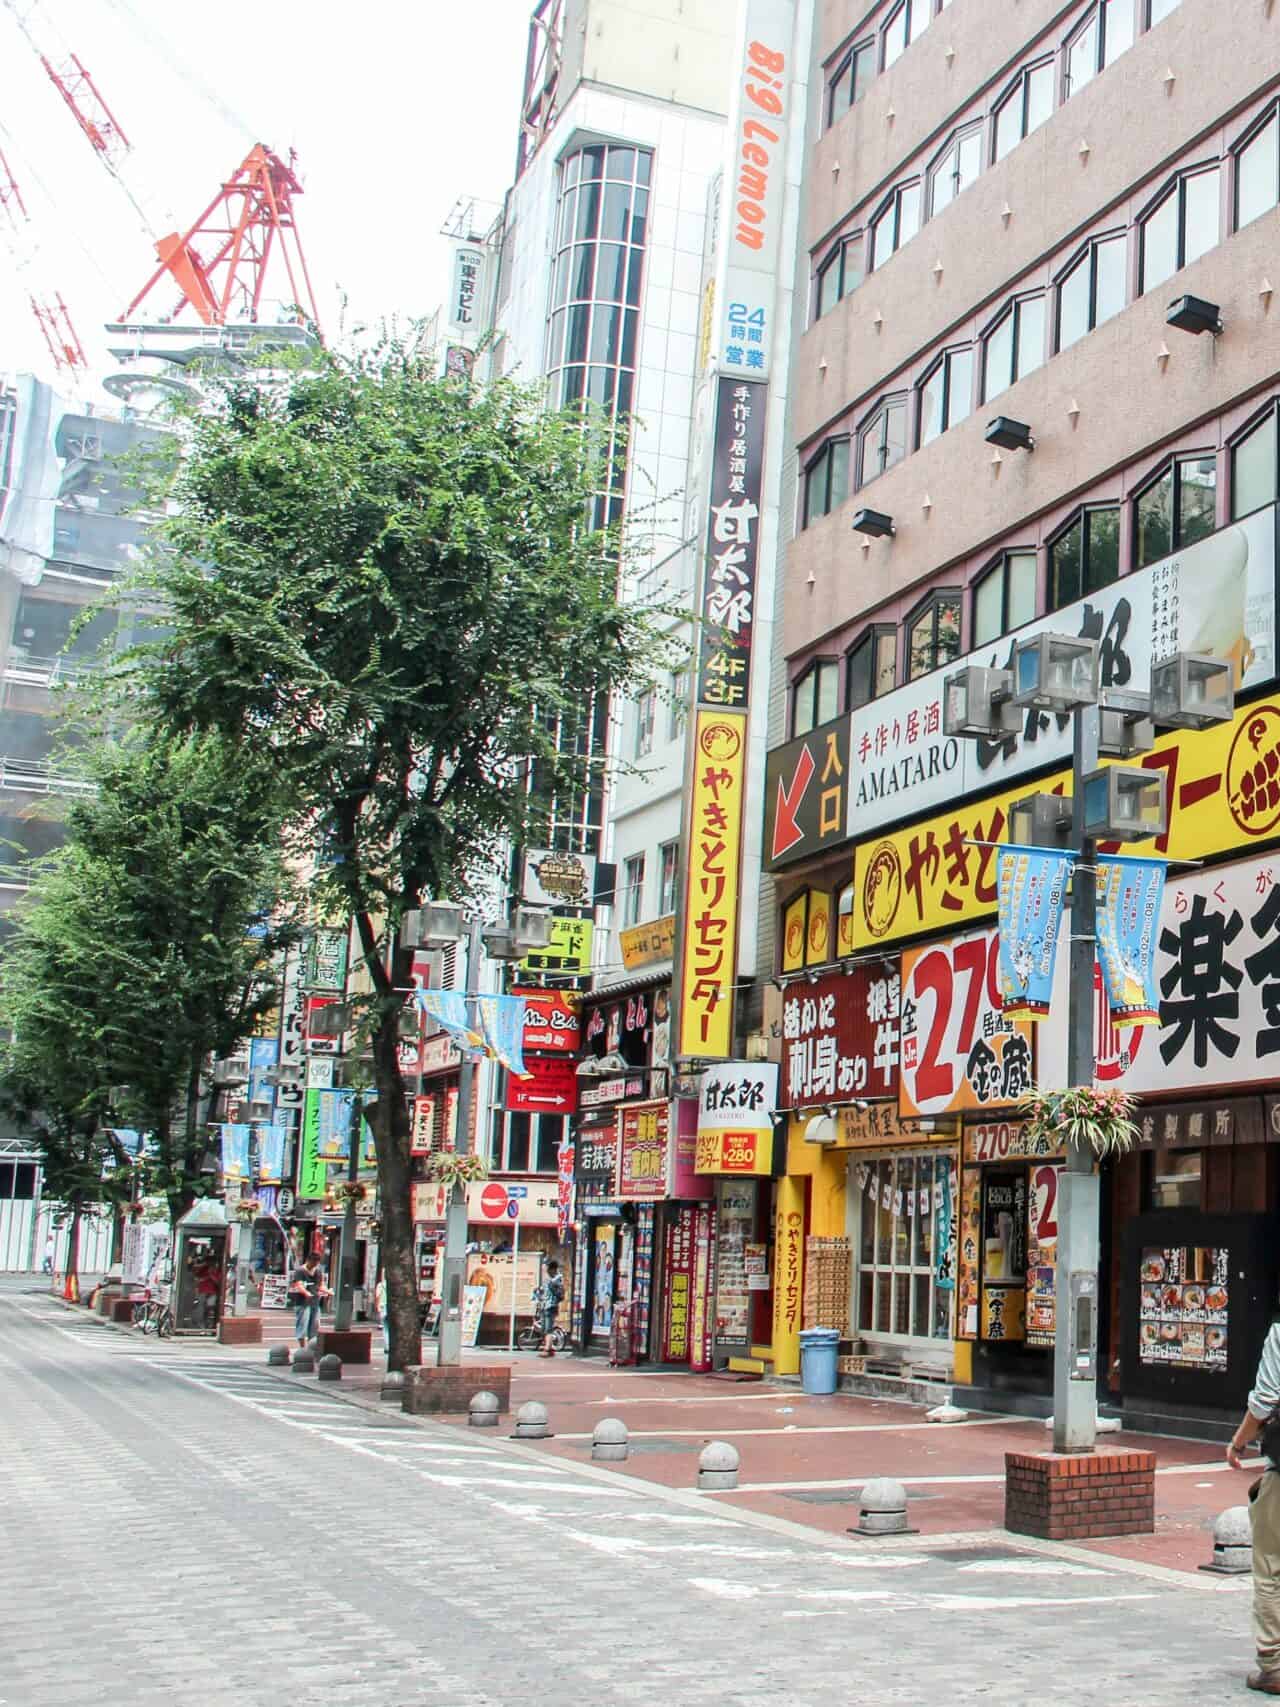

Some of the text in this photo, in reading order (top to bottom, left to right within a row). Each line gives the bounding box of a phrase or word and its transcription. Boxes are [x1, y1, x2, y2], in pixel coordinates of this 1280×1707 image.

[735, 38, 786, 252] Big Lemon
[456, 264, 477, 324] 東京ビル
[727, 302, 767, 328] 24
[725, 344, 767, 370] 営業
[730, 324, 764, 345] 時間
[728, 386, 752, 494] 手作り居酒屋
[706, 498, 760, 635] 甘太郎
[819, 732, 844, 841] 入口
[855, 735, 960, 810] AMATARO
[693, 765, 734, 1044] やきとりセンター
[705, 1078, 765, 1112] 甘太郎
[787, 1033, 868, 1101] 刺身あり
[965, 1034, 1032, 1105] 金の蔵
[785, 1228, 800, 1335] やきとりセンター
